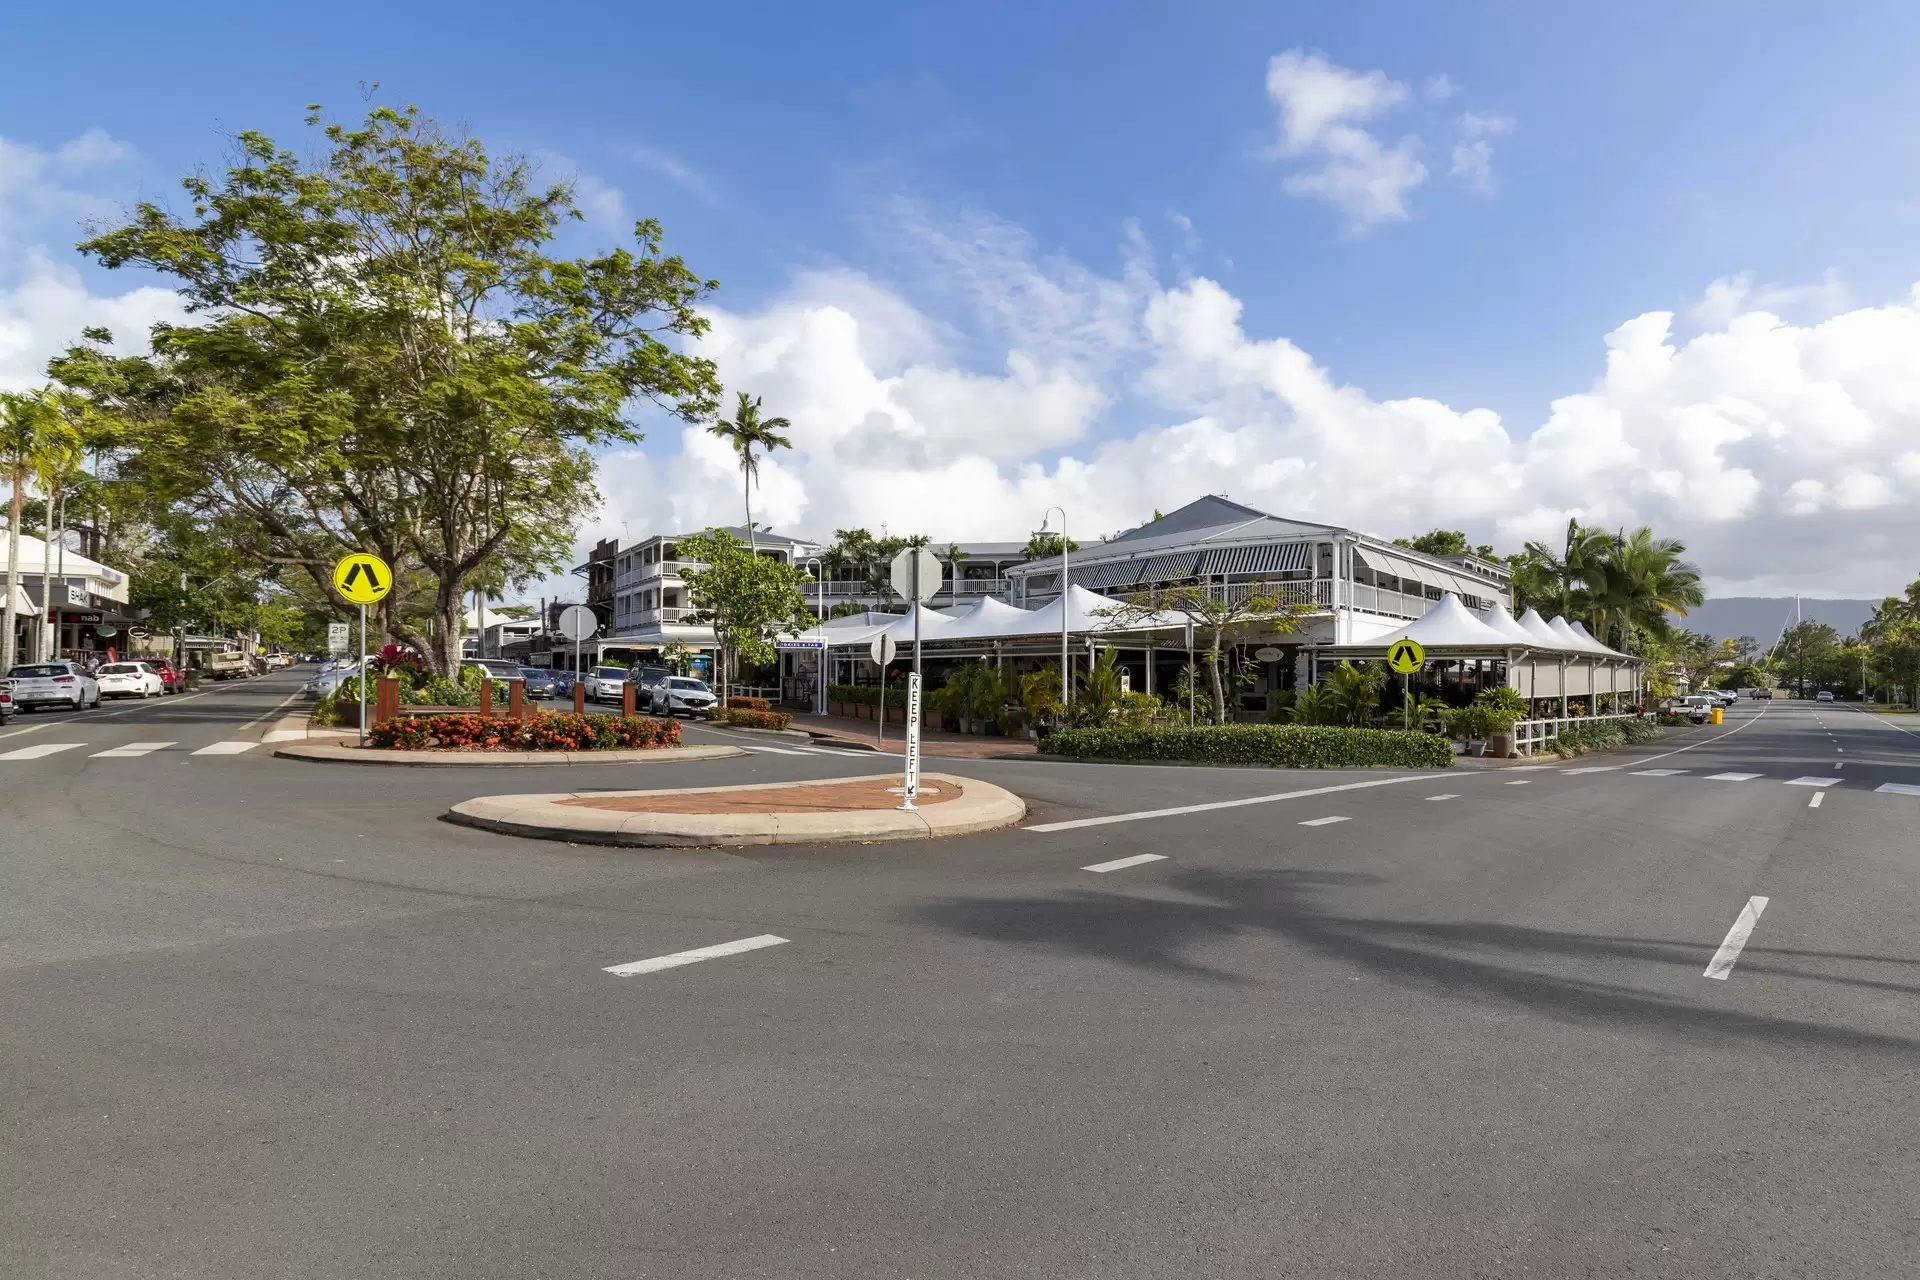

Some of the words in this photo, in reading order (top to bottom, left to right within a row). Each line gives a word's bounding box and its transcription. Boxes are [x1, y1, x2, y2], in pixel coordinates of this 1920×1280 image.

[81, 614, 99, 622] nab
[332, 626, 347, 634] 2P
[911, 678, 919, 727] KEEP
